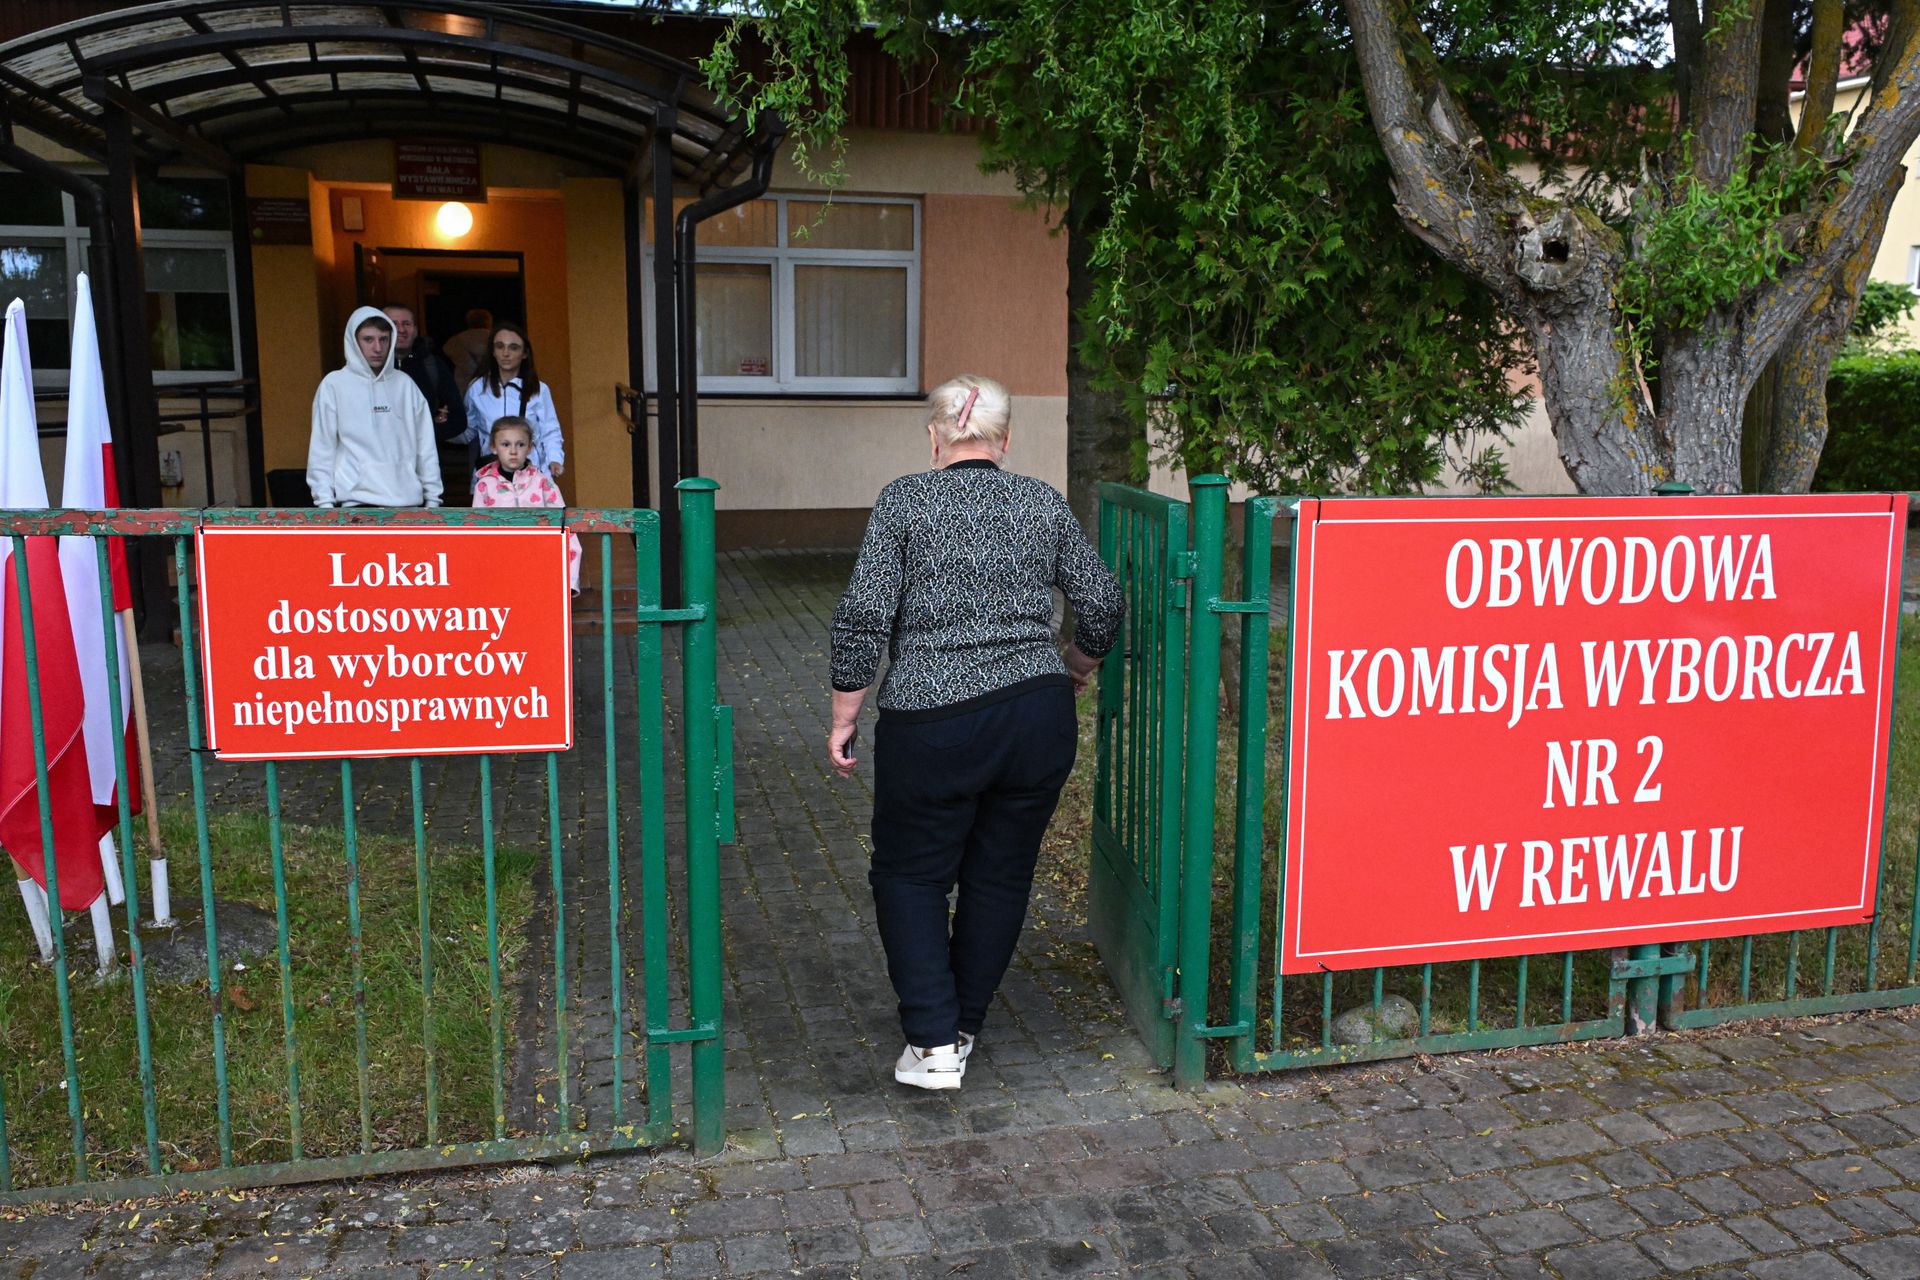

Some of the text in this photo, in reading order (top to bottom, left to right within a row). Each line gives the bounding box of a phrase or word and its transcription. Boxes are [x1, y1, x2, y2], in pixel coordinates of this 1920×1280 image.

[327, 552, 450, 587] Lokal
[1445, 533, 1777, 609] OBWODOWA
[267, 599, 511, 641] dostosowany
[253, 641, 528, 688] dla wyborców
[1324, 630, 1866, 729] KOMISJA WYBORCZA
[232, 686, 549, 735] niepełnosprawnych
[1542, 735, 1664, 809] NR 2
[1449, 825, 1744, 913] W REWALU
